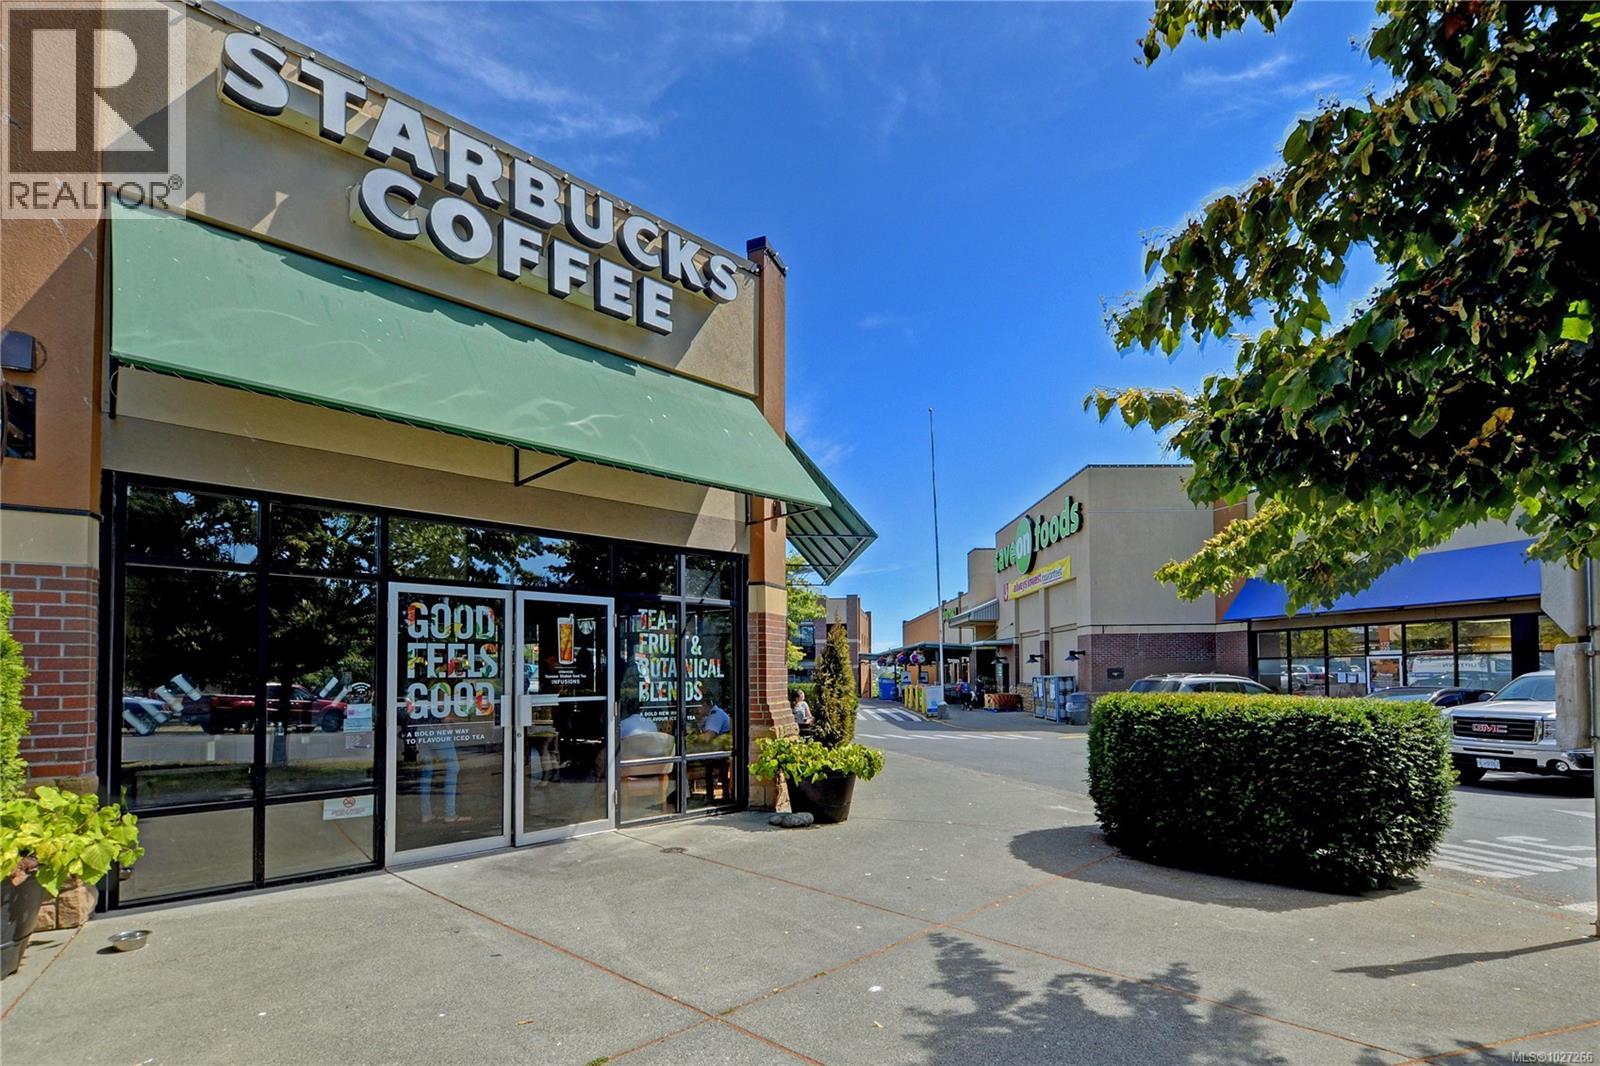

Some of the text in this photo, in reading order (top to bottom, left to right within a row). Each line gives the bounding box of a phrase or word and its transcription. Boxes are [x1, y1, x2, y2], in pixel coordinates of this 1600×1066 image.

[223, 32, 738, 304] STARBUCKS
[358, 167, 675, 336] COFFEE
[1033, 496, 1080, 552] foods
[407, 601, 495, 640] GOOD
[690, 635, 702, 656] &
[407, 642, 499, 679] FEELS
[638, 657, 725, 679] BOTANICAL
[551, 678, 581, 686] INFUSIONS
[638, 680, 703, 702] BLENDS
[406, 681, 495, 720] GOOD
[414, 730, 435, 738] BOLD
[418, 736, 452, 744] FLAVOUR
[453, 734, 470, 742] ICED
[472, 733, 485, 741] TEA
[1472, 723, 1508, 734] GMC
